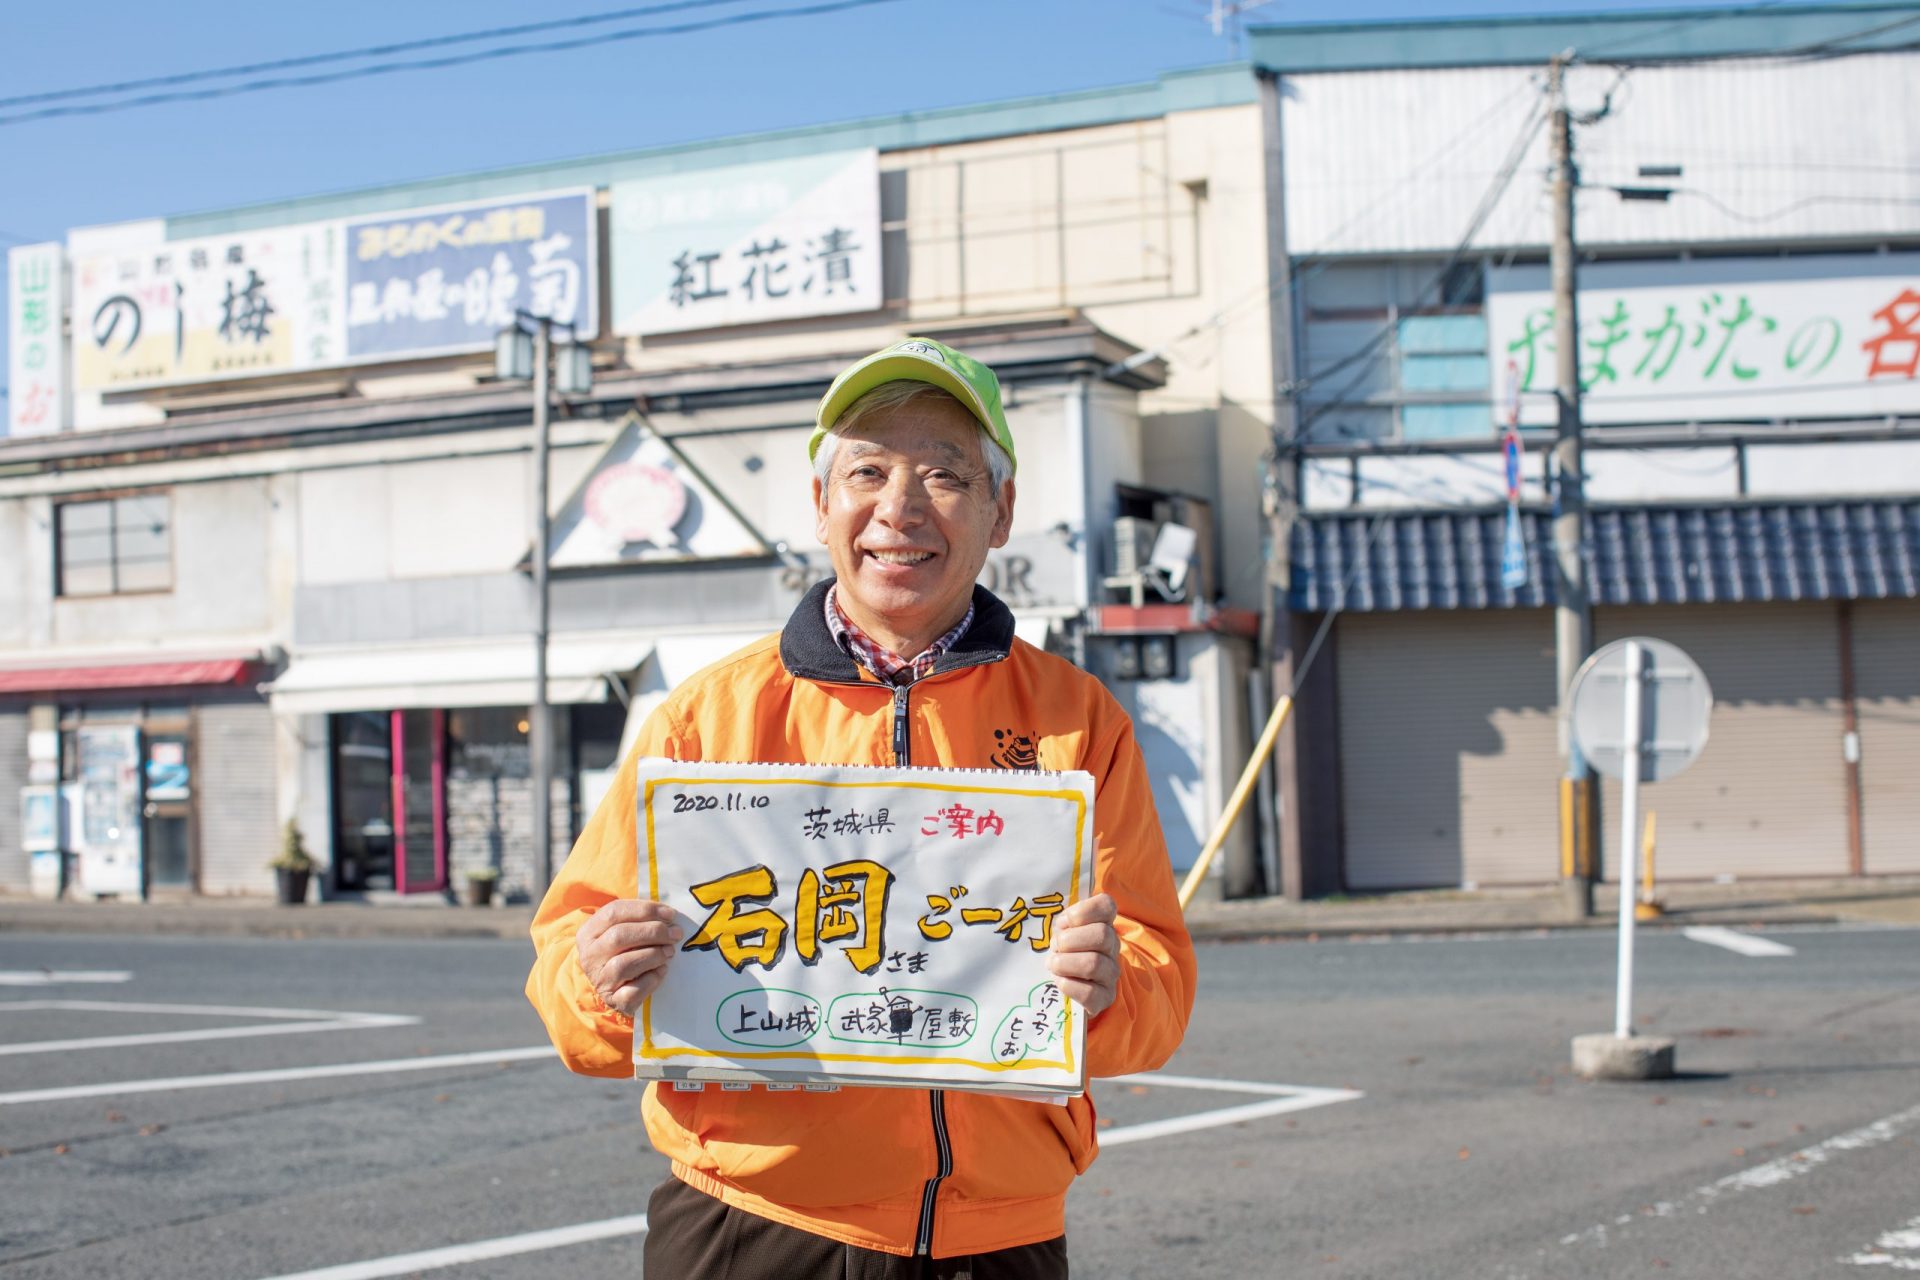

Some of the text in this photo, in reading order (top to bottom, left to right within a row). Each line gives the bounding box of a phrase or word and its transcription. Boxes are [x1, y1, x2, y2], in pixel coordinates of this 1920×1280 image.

[669, 226, 862, 308] 紅花漬
[91, 269, 275, 365] のし梅
[673, 792, 770, 814] 2020.11.10
[802, 805, 896, 839] 茨城県
[920, 802, 1005, 838] ご案内
[680, 858, 896, 975] 石岡
[916, 884, 1065, 953] ご一行
[884, 951, 930, 974] さま
[732, 1003, 820, 1035] 上山城
[1031, 983, 1060, 1036] たけうち
[1000, 1016, 1024, 1057] としお
